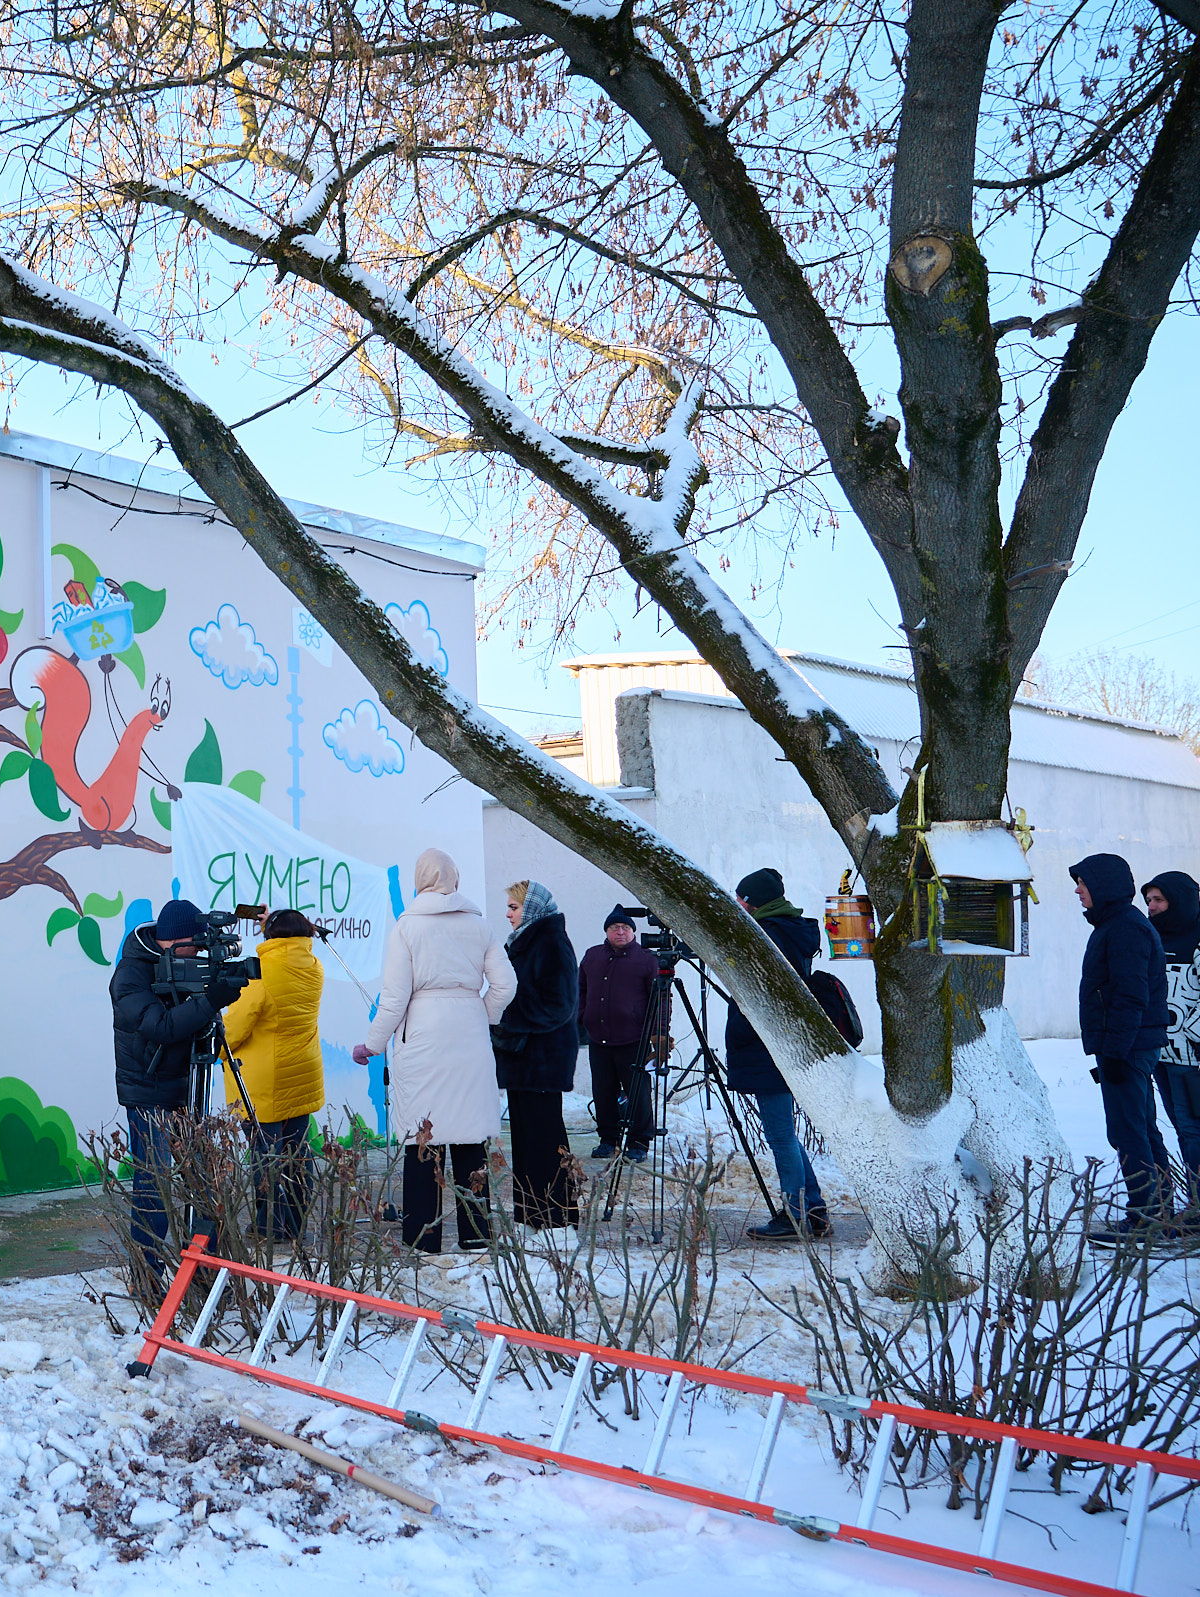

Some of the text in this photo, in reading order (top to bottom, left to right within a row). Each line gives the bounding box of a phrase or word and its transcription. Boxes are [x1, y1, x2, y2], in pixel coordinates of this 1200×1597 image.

[208, 851, 351, 913] Я УМЕЮ
[307, 916, 371, 940] ОГИЧНО
